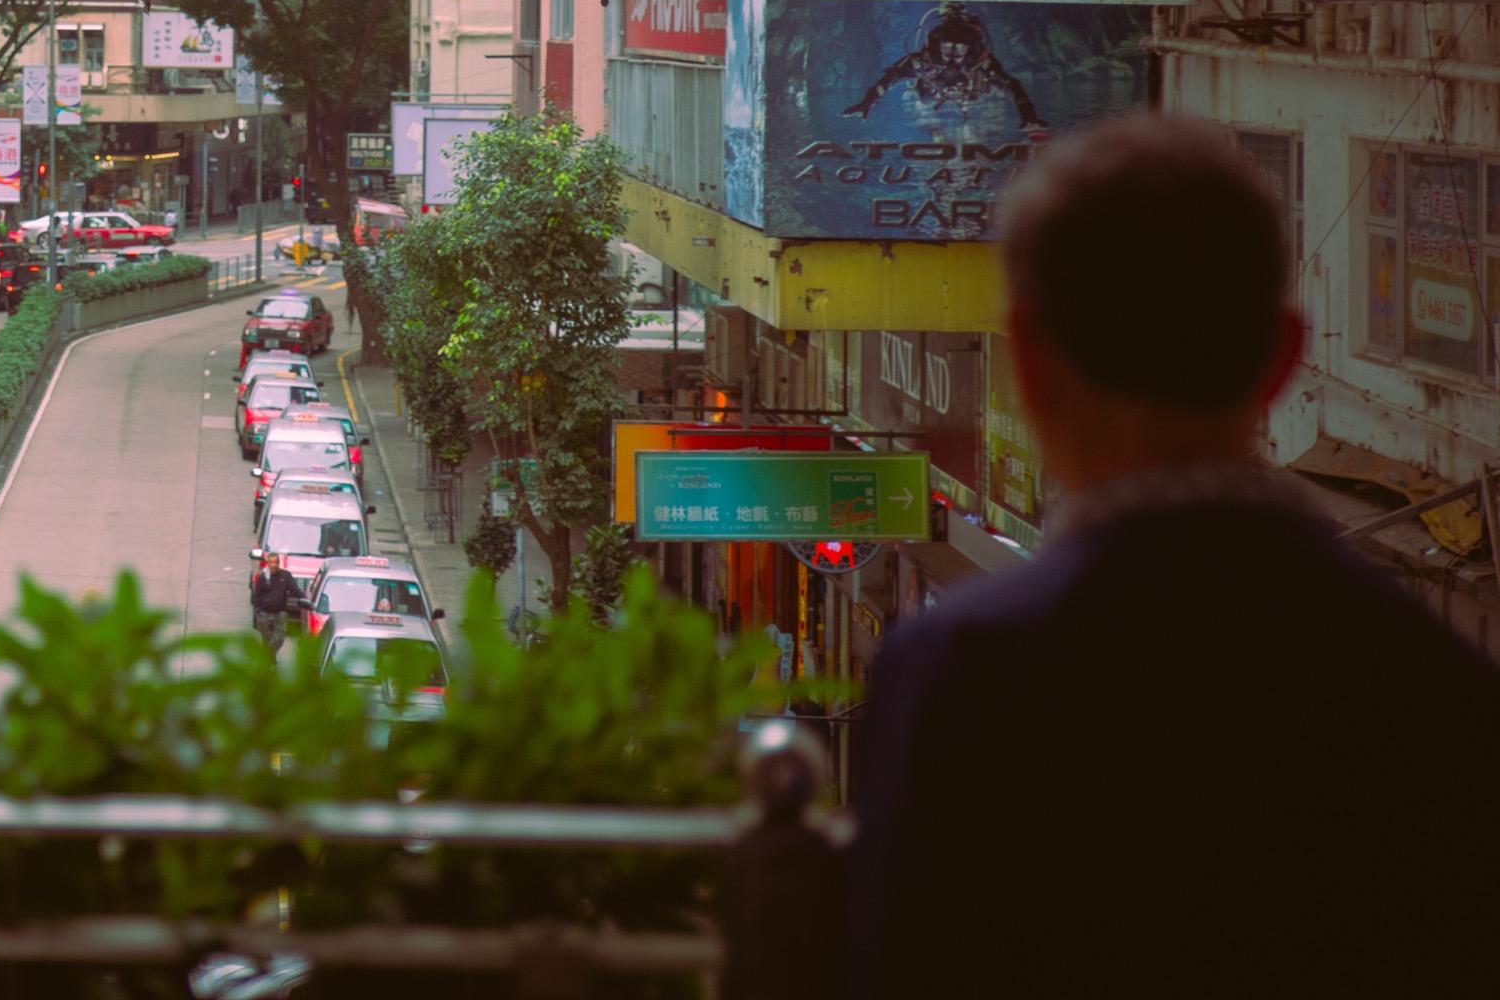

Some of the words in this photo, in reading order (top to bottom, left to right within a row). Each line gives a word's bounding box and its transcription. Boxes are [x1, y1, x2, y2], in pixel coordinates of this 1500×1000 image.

[797, 141, 1038, 162] ATOM
[881, 331, 950, 415] KINLND
[366, 614, 401, 624] TAXI
